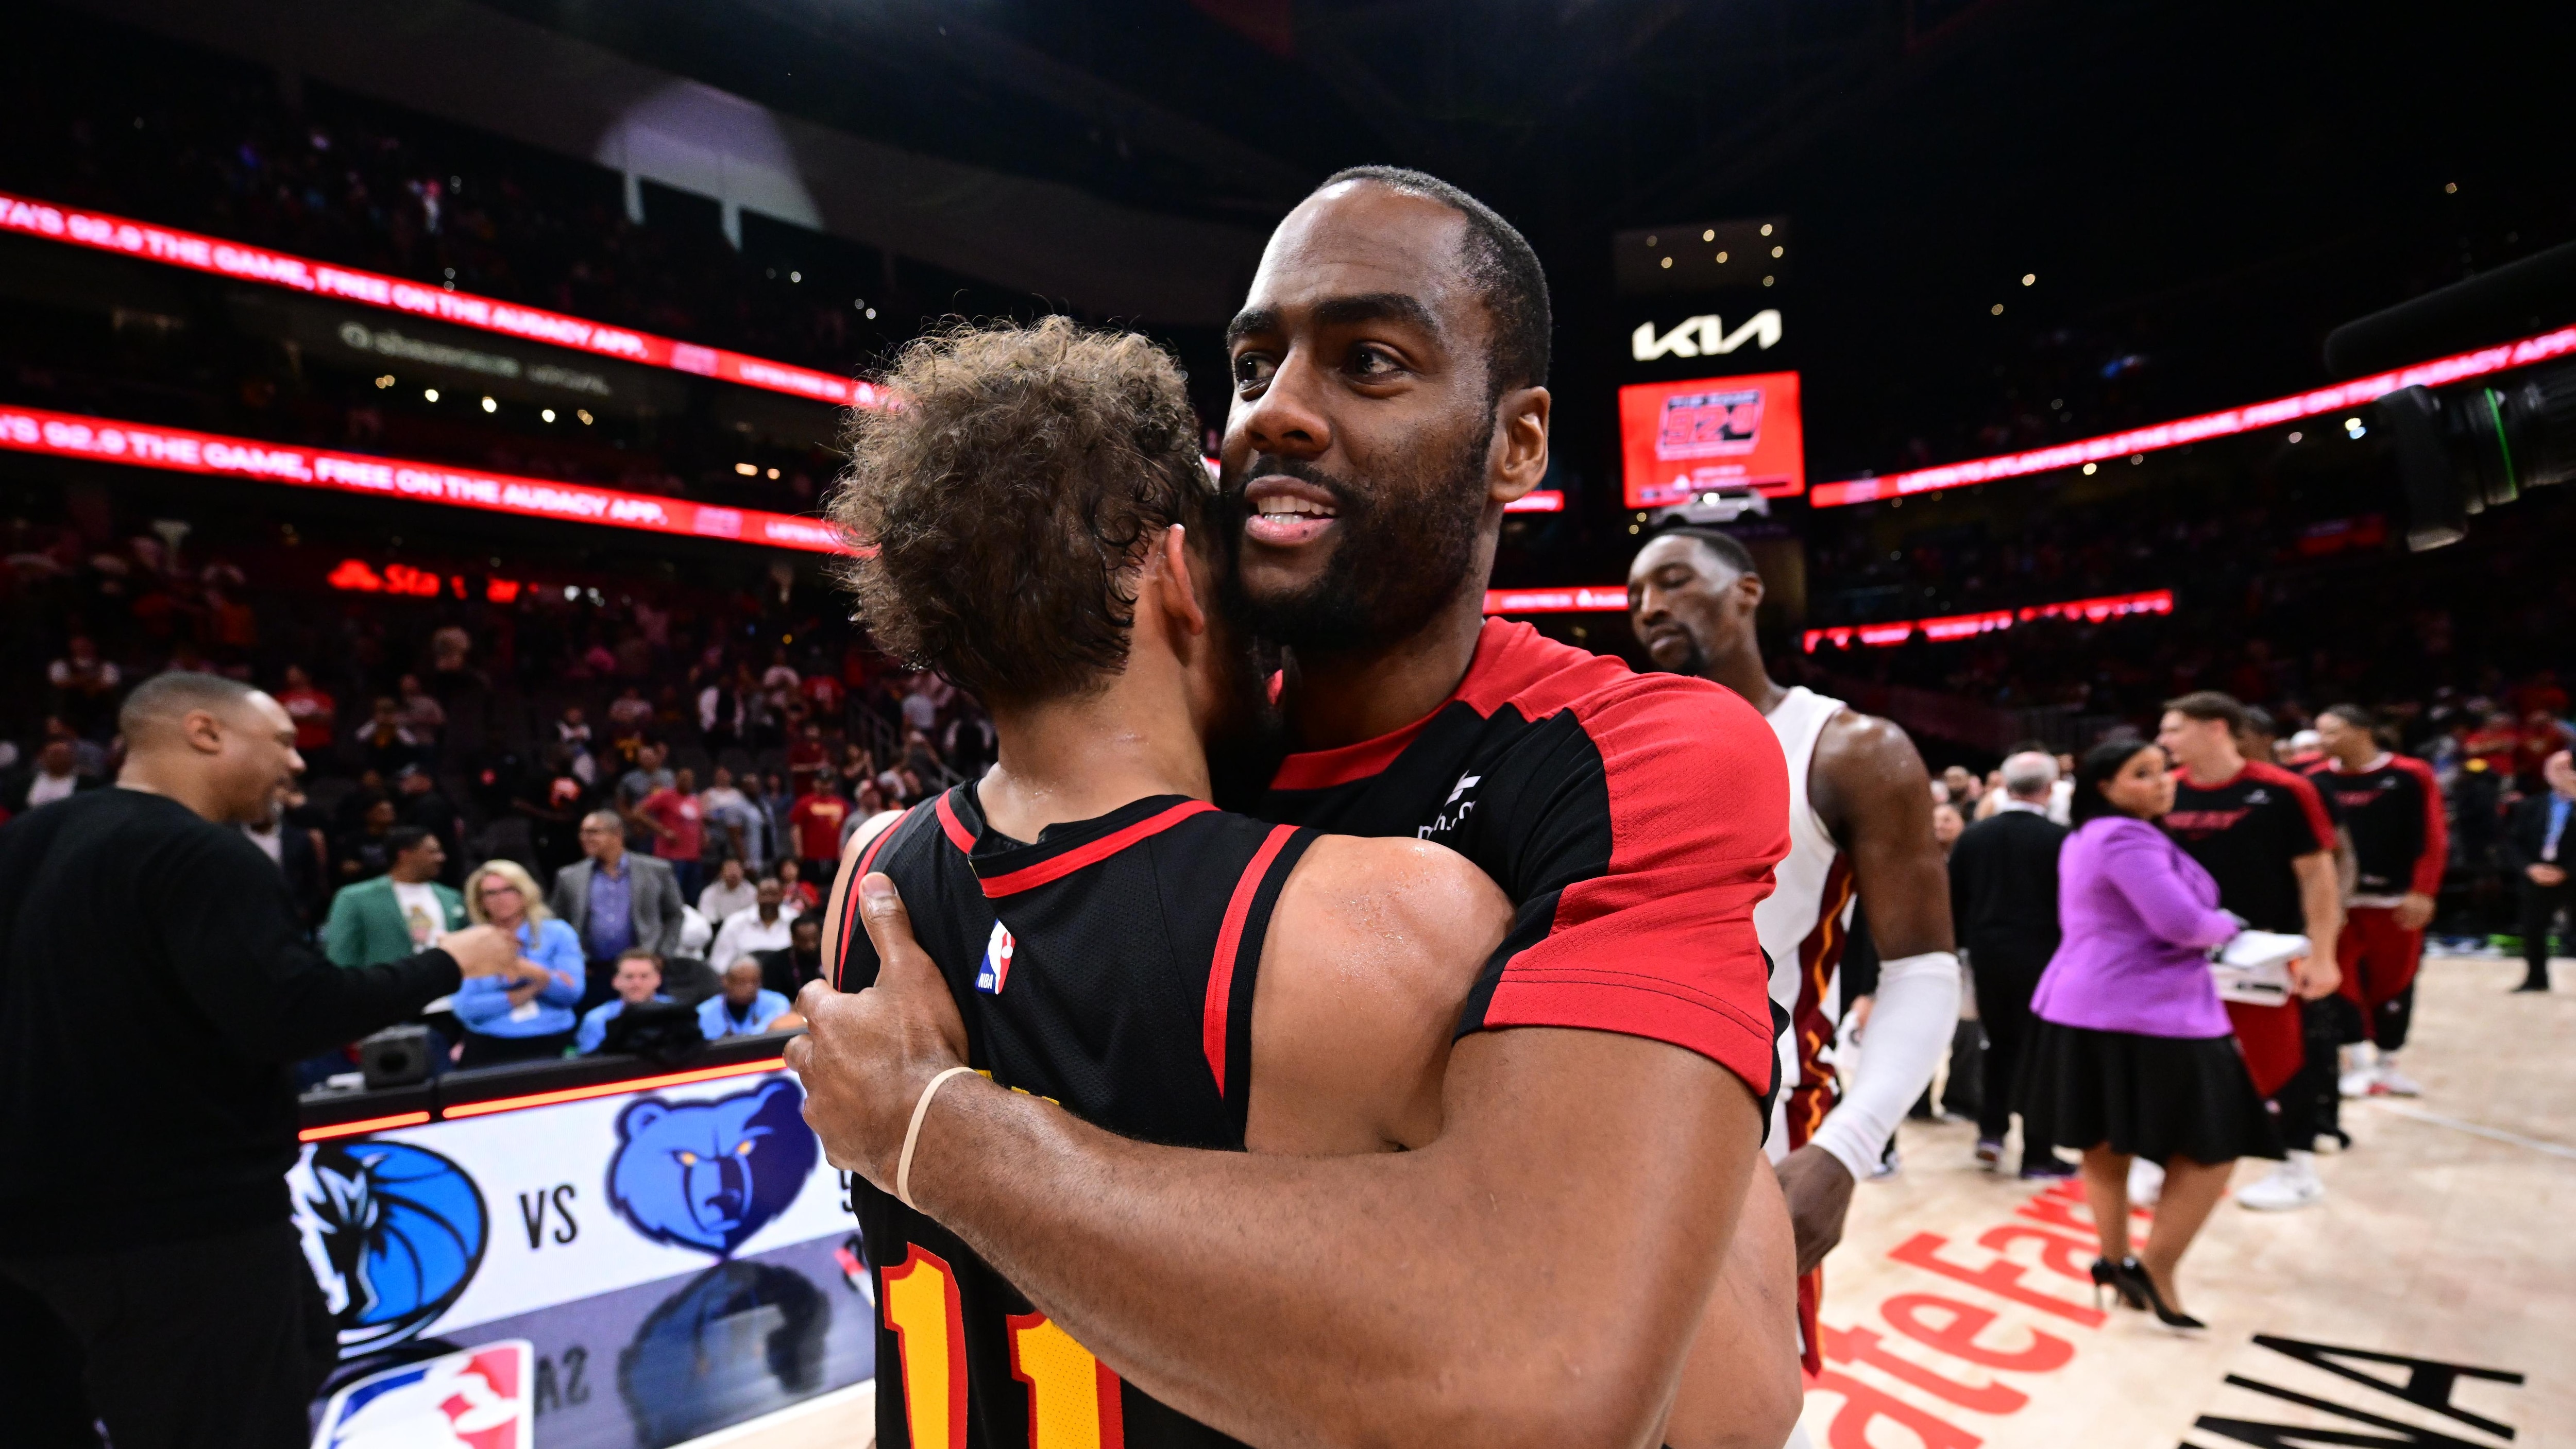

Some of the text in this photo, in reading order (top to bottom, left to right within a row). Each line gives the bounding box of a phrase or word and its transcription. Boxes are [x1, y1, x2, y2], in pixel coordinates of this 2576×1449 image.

[68, 214, 143, 252] 92.9
[145, 228, 210, 266] THE
[213, 245, 315, 292] GAME,
[316, 266, 391, 306] FREE
[391, 283, 438, 315] ON
[436, 292, 489, 327] THE
[490, 305, 592, 348] AUDACY
[591, 327, 649, 360] APP.
[43, 420, 126, 456] 92.9
[128, 430, 200, 466] THE
[202, 441, 313, 482] GAME,
[315, 455, 395, 492] FREE
[395, 467, 444, 498] ON
[443, 472, 501, 507] THE
[500, 481, 609, 520] AUDACY
[608, 497, 669, 529] APP.
[978, 973, 994, 990] NBA
[519, 1183, 578, 1251] VS
[880, 1241, 1124, 1449] 11
